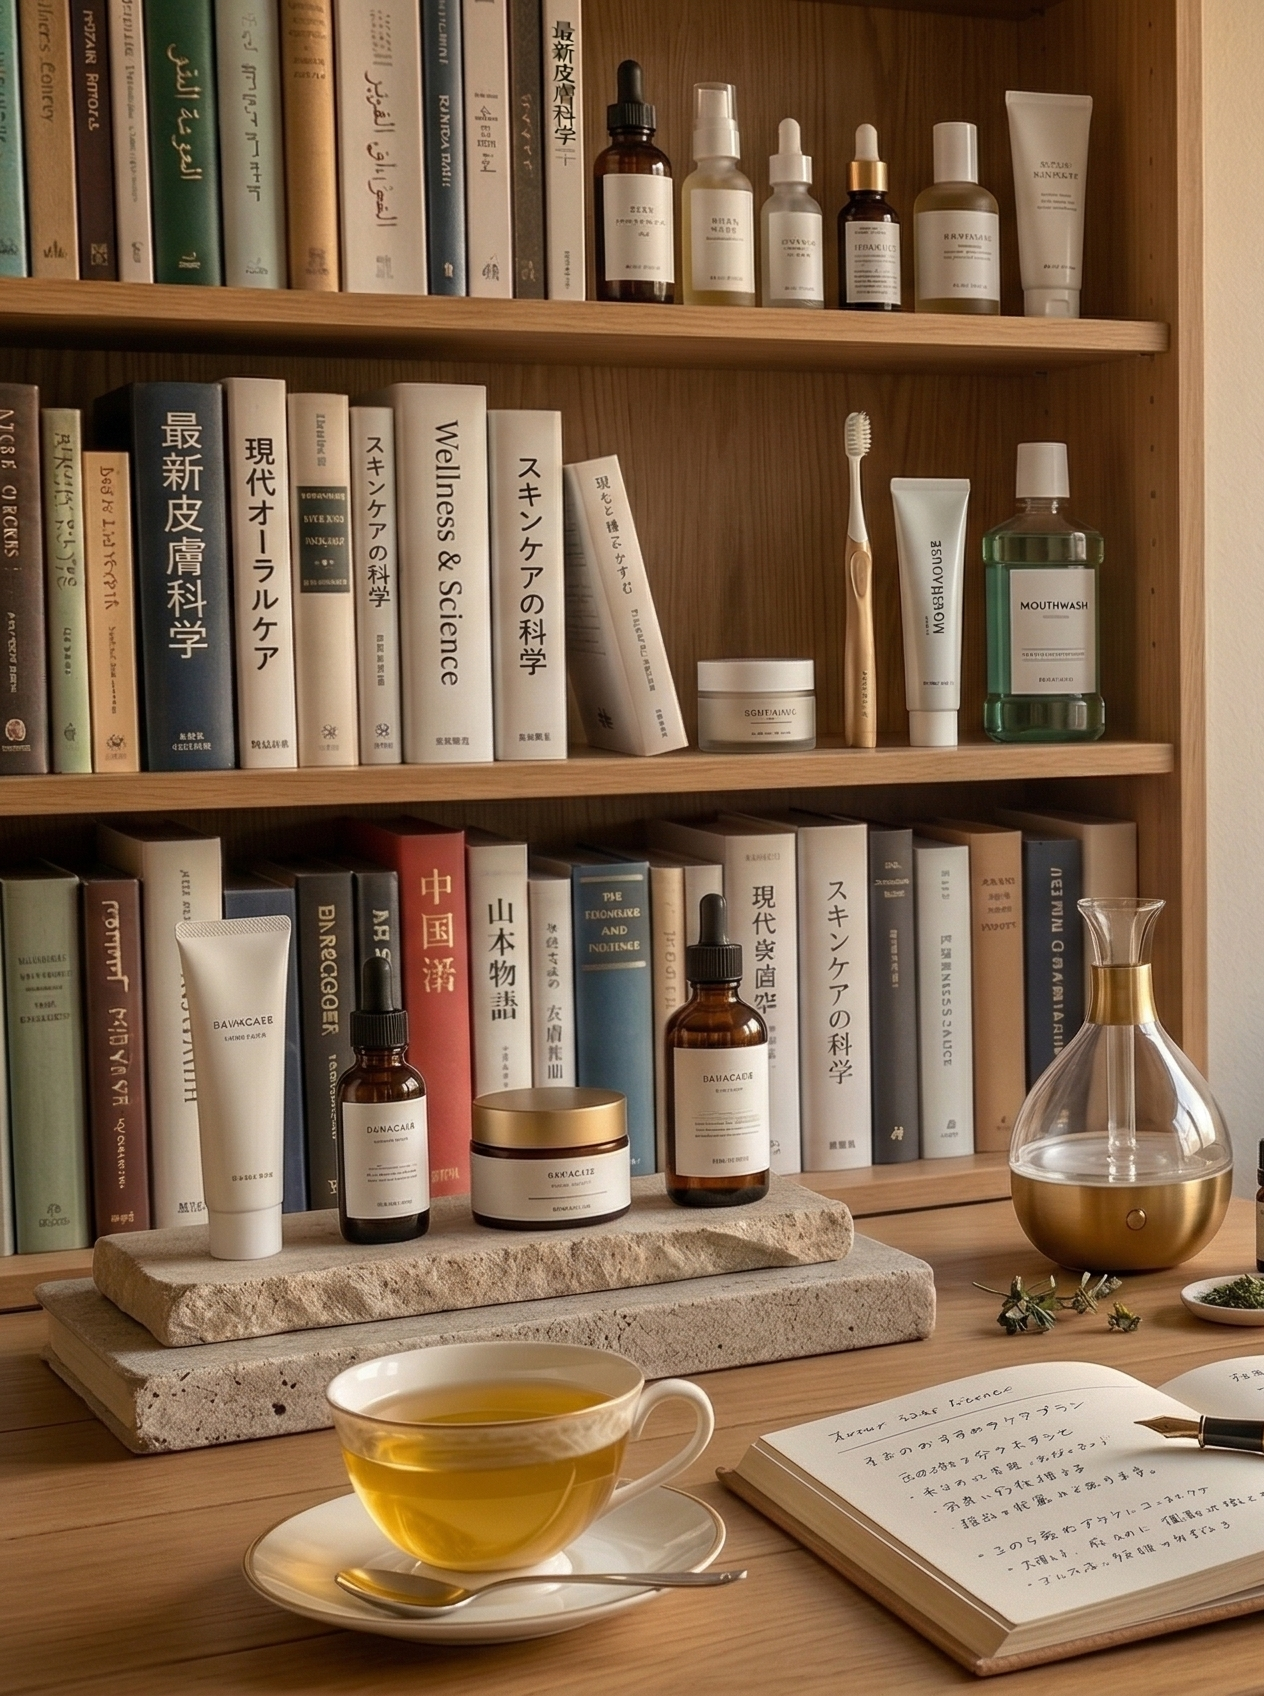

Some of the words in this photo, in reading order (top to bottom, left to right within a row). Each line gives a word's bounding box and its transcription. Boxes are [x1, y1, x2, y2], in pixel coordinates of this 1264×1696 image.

[161, 411, 208, 659] 最新皮膚科学
[244, 437, 280, 671] 現代オーラルケア
[365, 436, 391, 608] スキンケアの科学
[434, 420, 461, 542] Wellness
[438, 550, 462, 572] &
[439, 580, 463, 686] Science
[517, 457, 548, 675] スキンケアの科学
[1020, 601, 1089, 611] MOUTHWASH
[601, 925, 628, 936] AND
[827, 880, 853, 1085] スキンケアの科学
